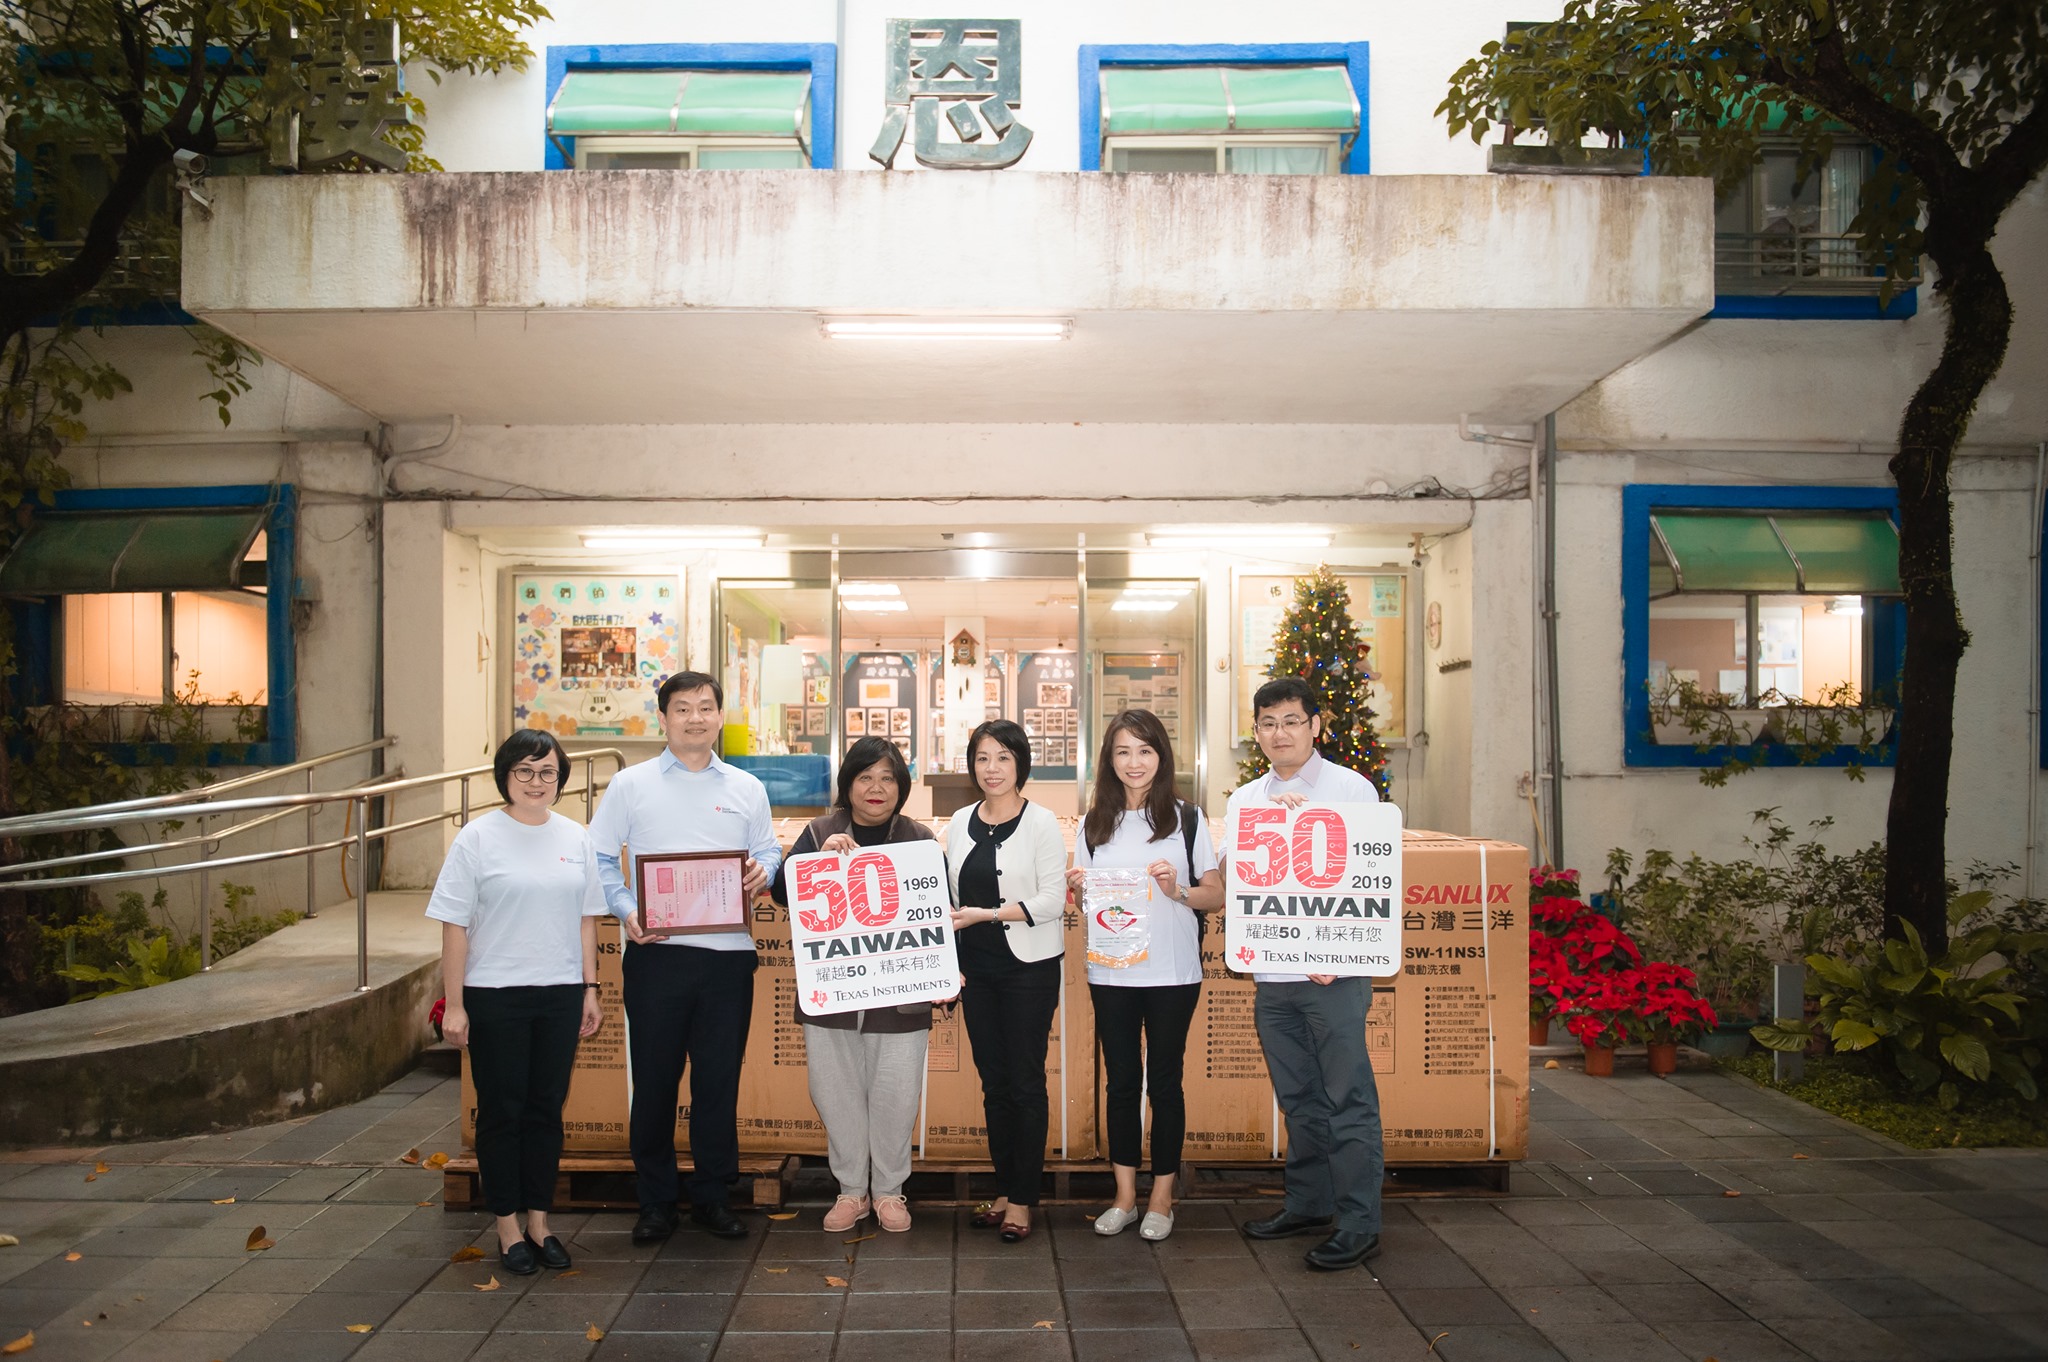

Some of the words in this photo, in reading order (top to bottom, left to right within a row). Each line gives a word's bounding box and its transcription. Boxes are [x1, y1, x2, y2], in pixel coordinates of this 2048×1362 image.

[868, 18, 1034, 170] 恩
[1236, 808, 1347, 889] 50
[1352, 842, 1392, 856] 1969
[1367, 860, 1377, 868] to
[903, 876, 938, 891] 1969
[1351, 875, 1392, 889] 2019
[796, 852, 899, 932] 50
[918, 893, 926, 901] to
[1404, 884, 1514, 905] SANLUX
[906, 906, 942, 922] 2019
[1236, 894, 1390, 919] TAIWAN
[1402, 910, 1514, 931] 台灣三洋
[803, 926, 945, 961] TAIWAN
[1261, 950, 1300, 962] TEXAS
[1304, 951, 1390, 965] INSTRUMENTS
[1404, 946, 1485, 959] SW-11NS3
[1404, 964, 1461, 976] 電動洗衣機
[833, 988, 869, 1002] TEXAS
[873, 979, 951, 997] INSTRUMENTS
[1186, 1131, 1265, 1142] 電機股份有限公司
[1384, 1128, 1484, 1139] 三洋電機股份有限公司
